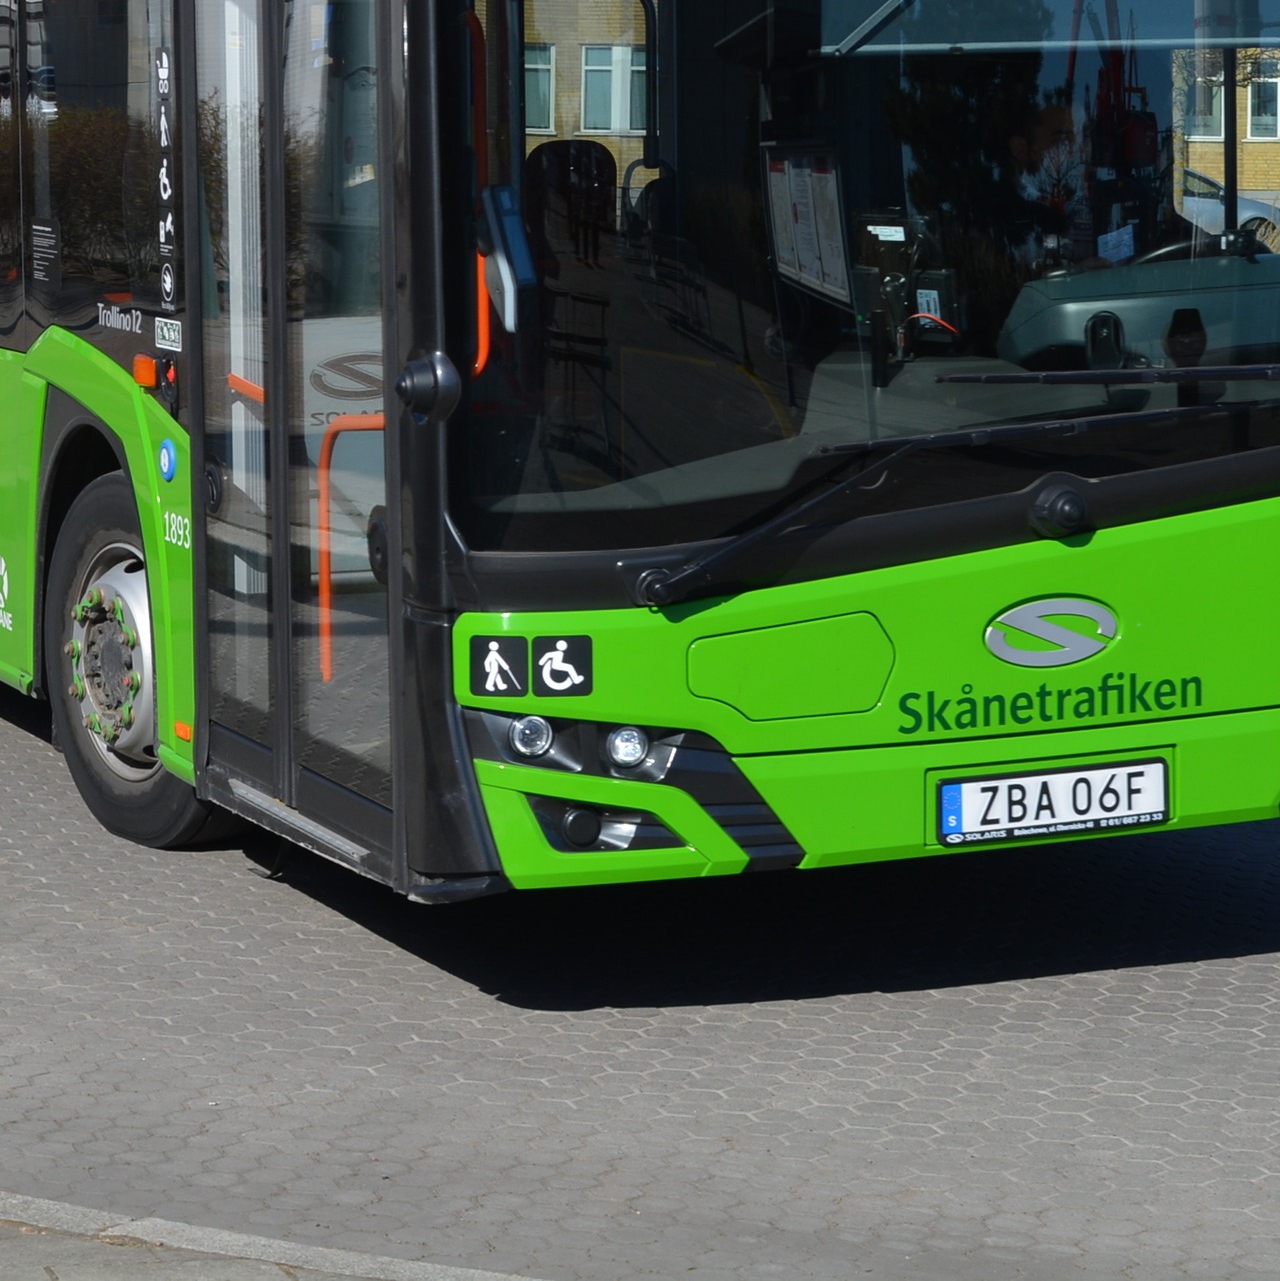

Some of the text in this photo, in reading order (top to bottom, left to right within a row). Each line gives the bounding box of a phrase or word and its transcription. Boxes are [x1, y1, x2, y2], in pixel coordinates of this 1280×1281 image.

[97, 302, 142, 334] Trollino 12
[163, 511, 190, 549] 1893
[897, 671, 1203, 735] Skånetrafiken
[947, 770, 1146, 827] S ZBA 06F
[964, 829, 1007, 841] SOLARIS
